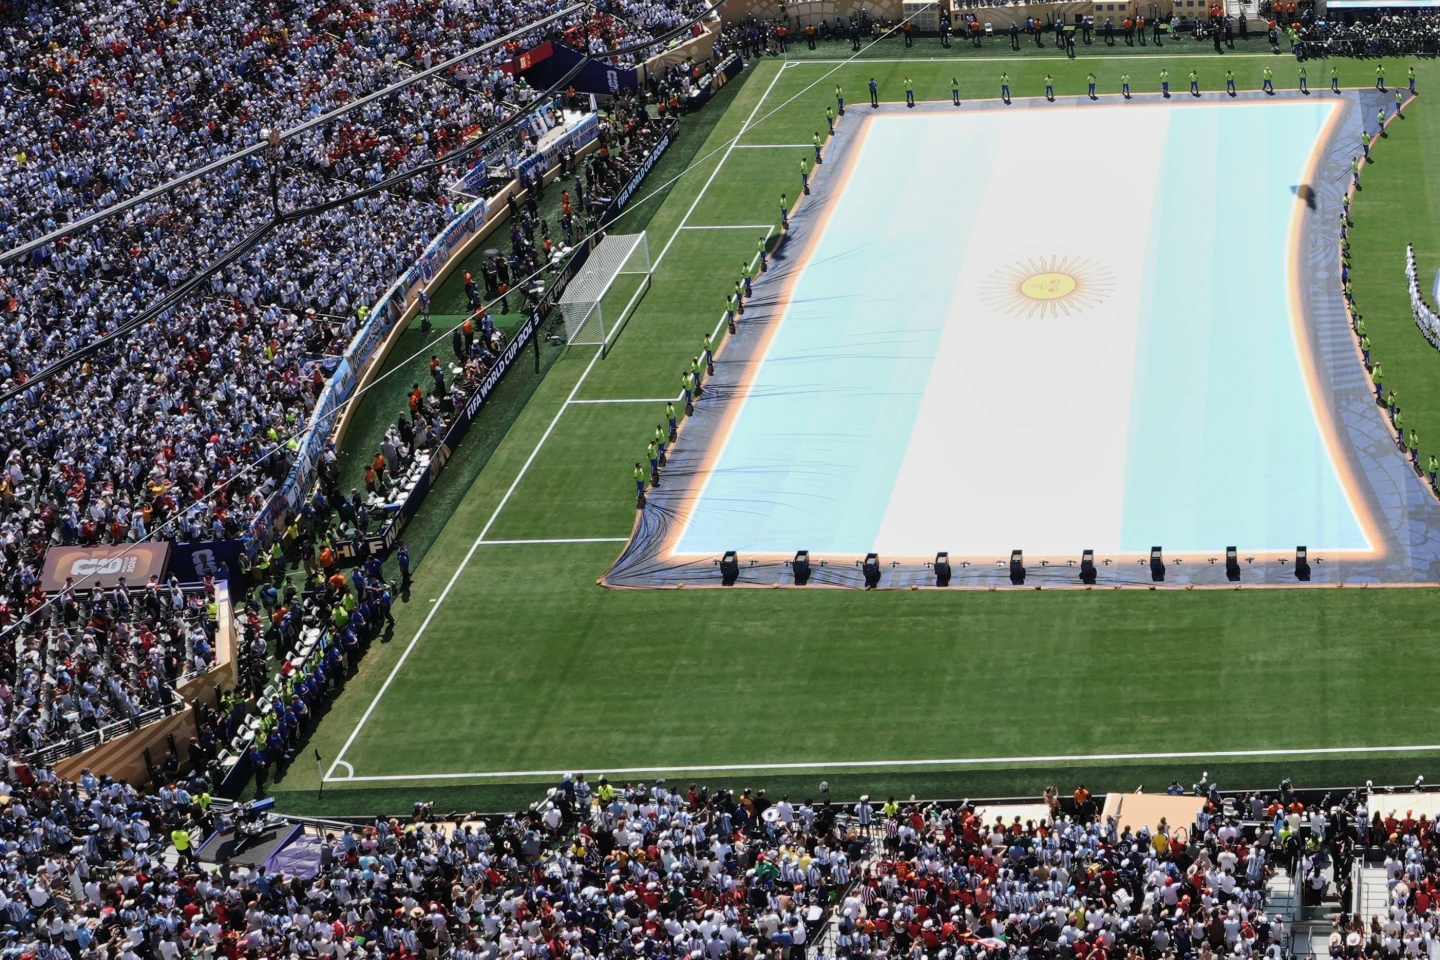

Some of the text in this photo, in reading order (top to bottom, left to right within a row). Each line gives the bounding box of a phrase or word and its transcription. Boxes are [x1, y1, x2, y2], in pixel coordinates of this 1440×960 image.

[617, 190, 629, 209] FIFA
[627, 168, 645, 195] WORLD
[644, 155, 654, 173] CUP
[653, 135, 669, 162] 2026
[466, 394, 482, 420] FIFA
[480, 362, 506, 398] WORLD
[504, 343, 519, 365] CUP
[553, 266, 574, 302] FINAL
[127, 556, 137, 573] 2026
